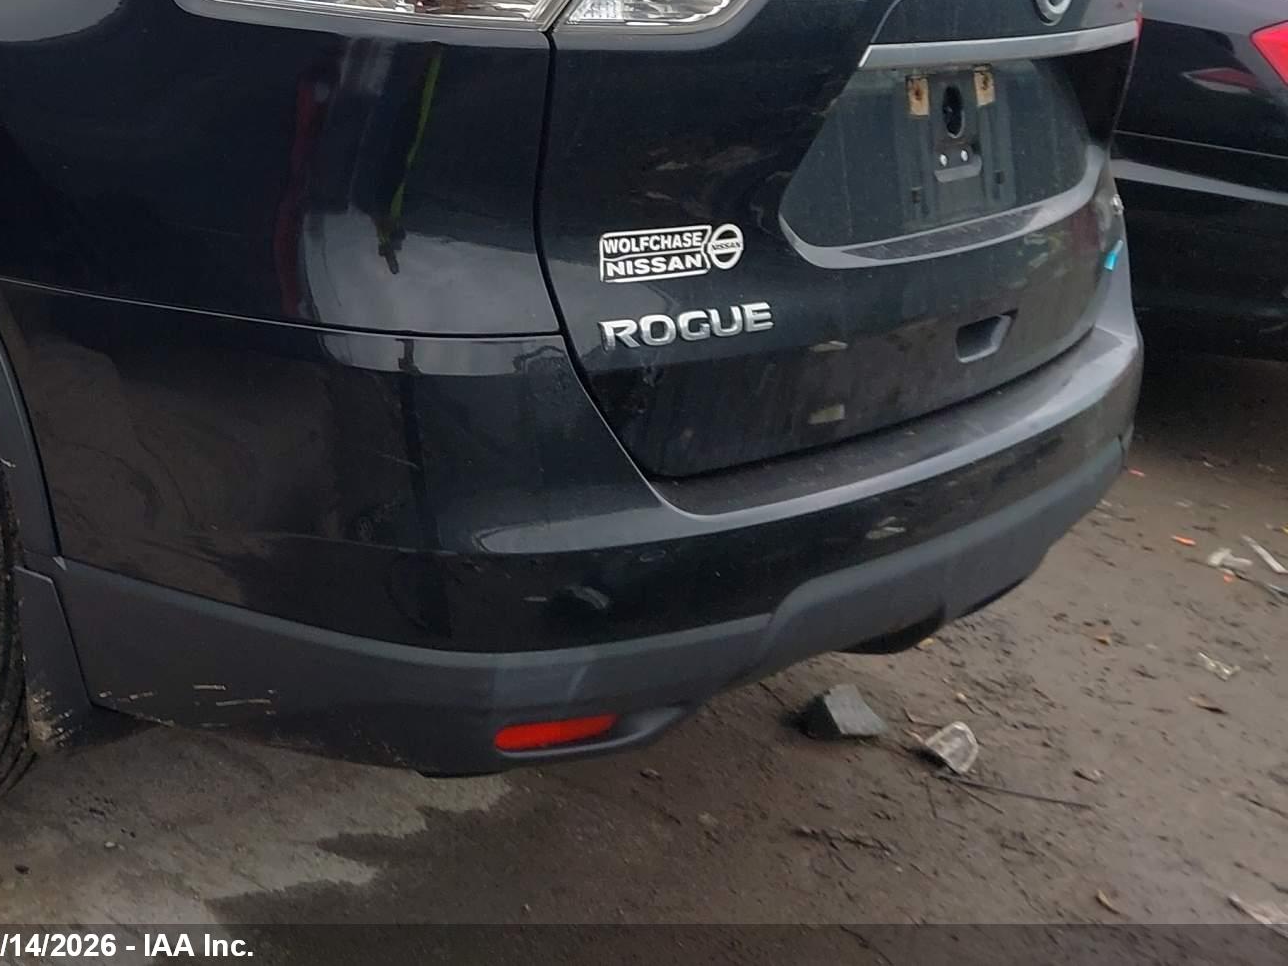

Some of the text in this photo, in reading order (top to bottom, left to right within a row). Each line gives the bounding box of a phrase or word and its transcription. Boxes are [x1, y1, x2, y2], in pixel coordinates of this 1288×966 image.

[603, 231, 703, 255] WOLFCHASE
[606, 253, 702, 277] NISSAN
[598, 302, 774, 351] ROGUE
